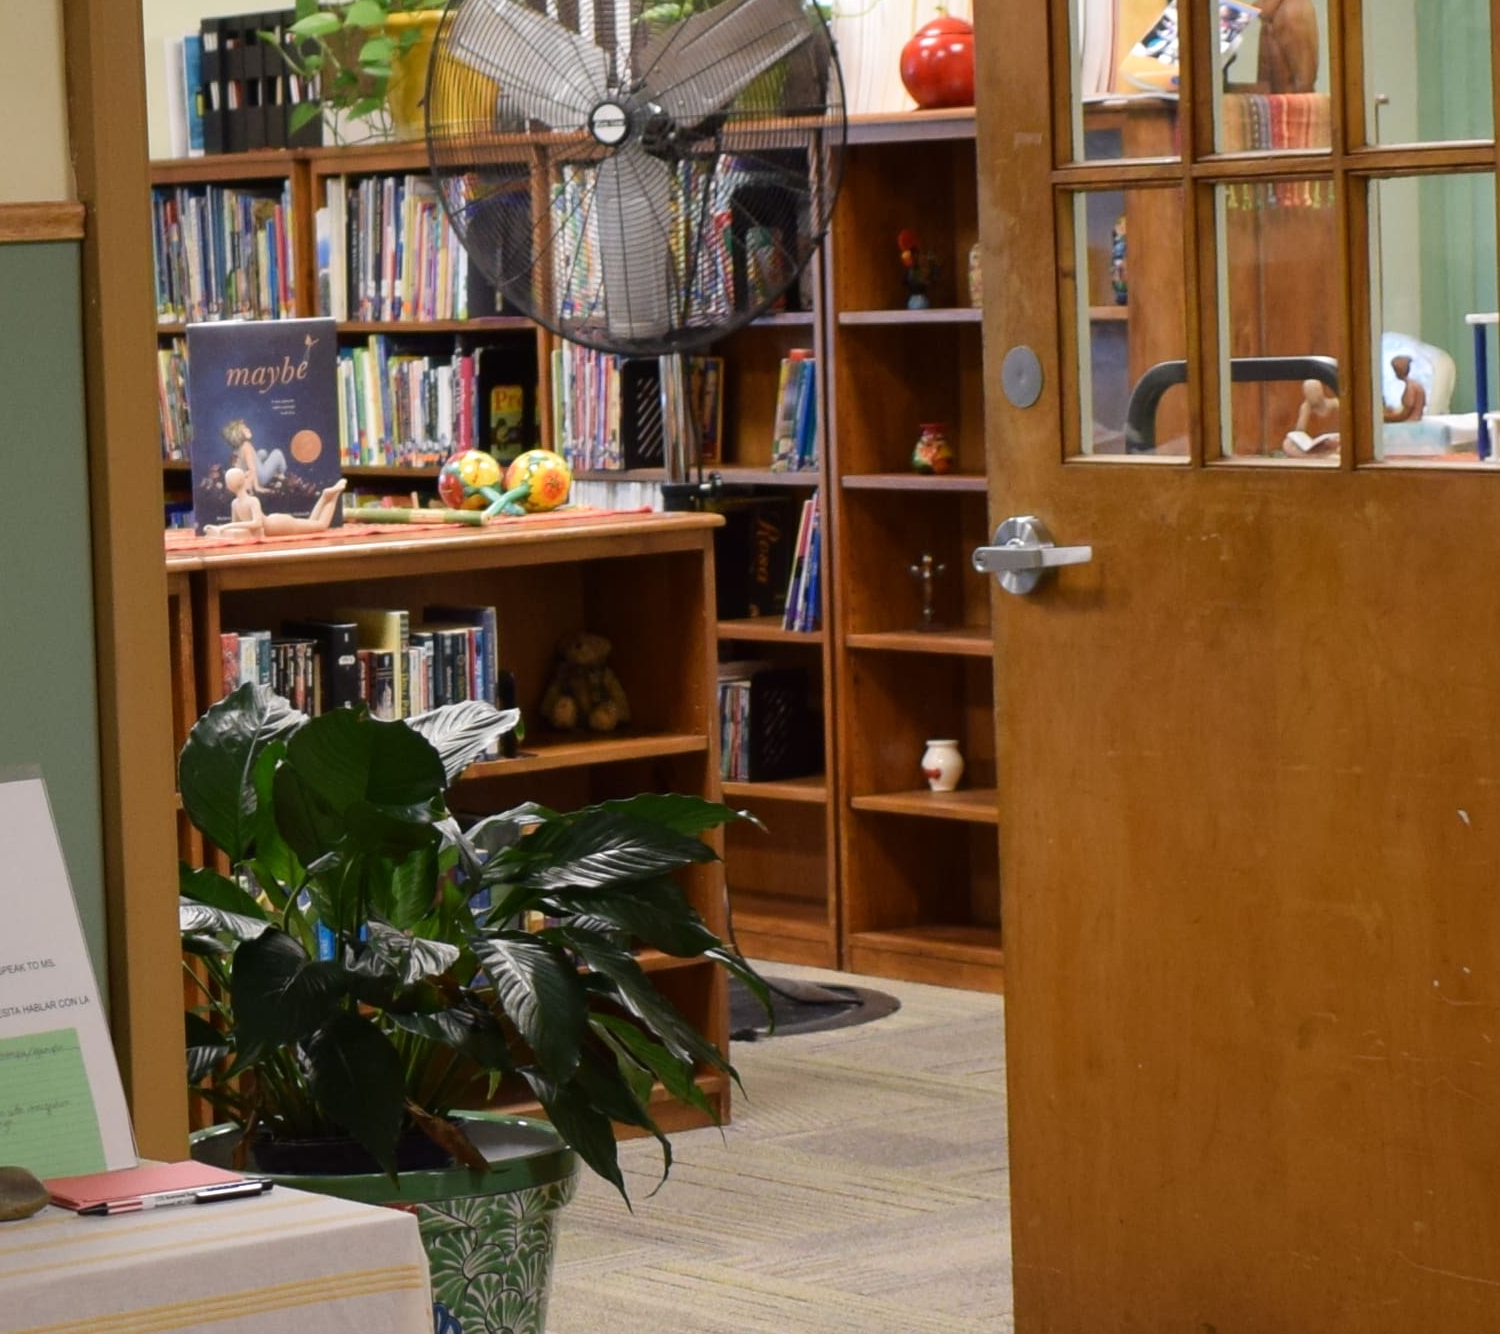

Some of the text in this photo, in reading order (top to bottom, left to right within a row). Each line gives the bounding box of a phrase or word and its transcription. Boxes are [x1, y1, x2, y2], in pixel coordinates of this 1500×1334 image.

[226, 356, 308, 394] maybe
[26, 961, 39, 972] TO
[40, 958, 56, 969] MS.
[22, 1002, 57, 1015] HABLAR
[58, 998, 77, 1010] CON
[78, 996, 90, 1007] LA
